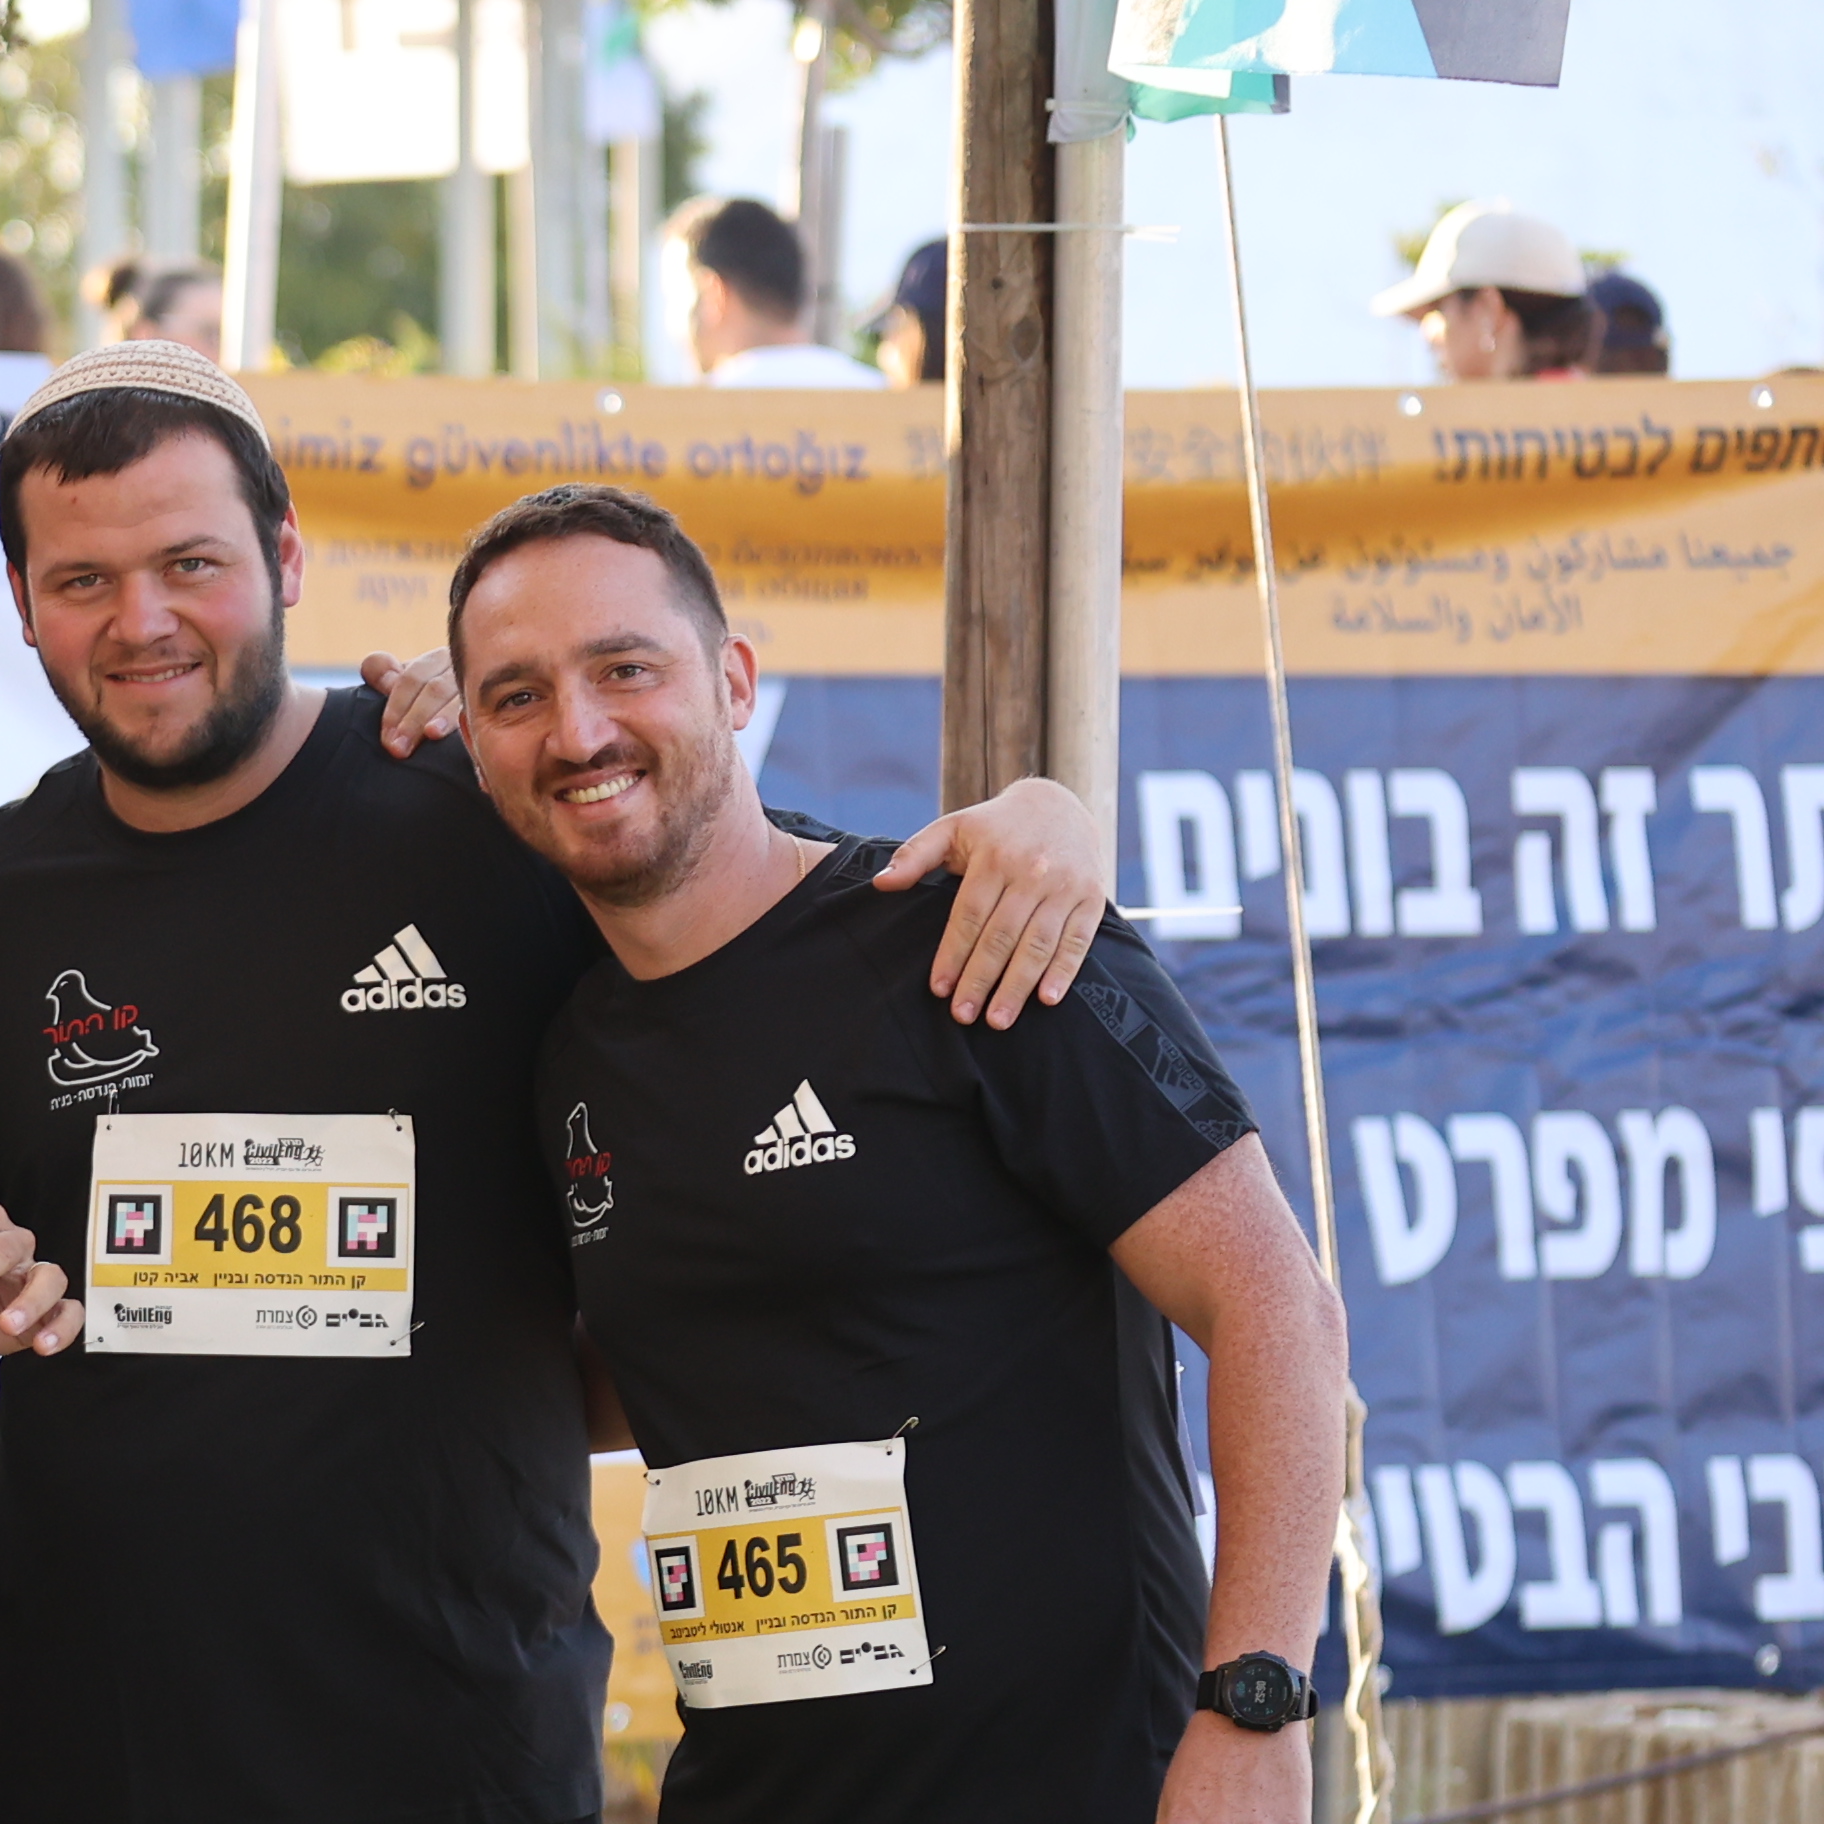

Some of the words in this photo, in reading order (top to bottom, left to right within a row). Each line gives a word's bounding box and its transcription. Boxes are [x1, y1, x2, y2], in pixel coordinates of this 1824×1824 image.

[1690, 424, 1824, 476] תפים
[1138, 768, 1483, 940] בונים
[1512, 765, 1657, 935] זה
[340, 977, 468, 1014] adidas
[177, 1141, 235, 1168] 10KM
[743, 1129, 857, 1176] adidas
[1354, 1108, 1717, 1286] מפרט
[193, 1192, 303, 1254] 468
[132, 1271, 160, 1285] קטן
[164, 1271, 200, 1284] אביה
[213, 1272, 250, 1287] ובניין
[253, 1272, 303, 1285] הנדסה
[308, 1273, 346, 1286] התור
[350, 1273, 367, 1290] קן
[695, 1485, 740, 1517] 10KM
[1317, 1460, 1682, 1634] הבטי
[716, 1532, 808, 1601] 465
[791, 1611, 836, 1627] הנדסה
[840, 1605, 877, 1621] התור
